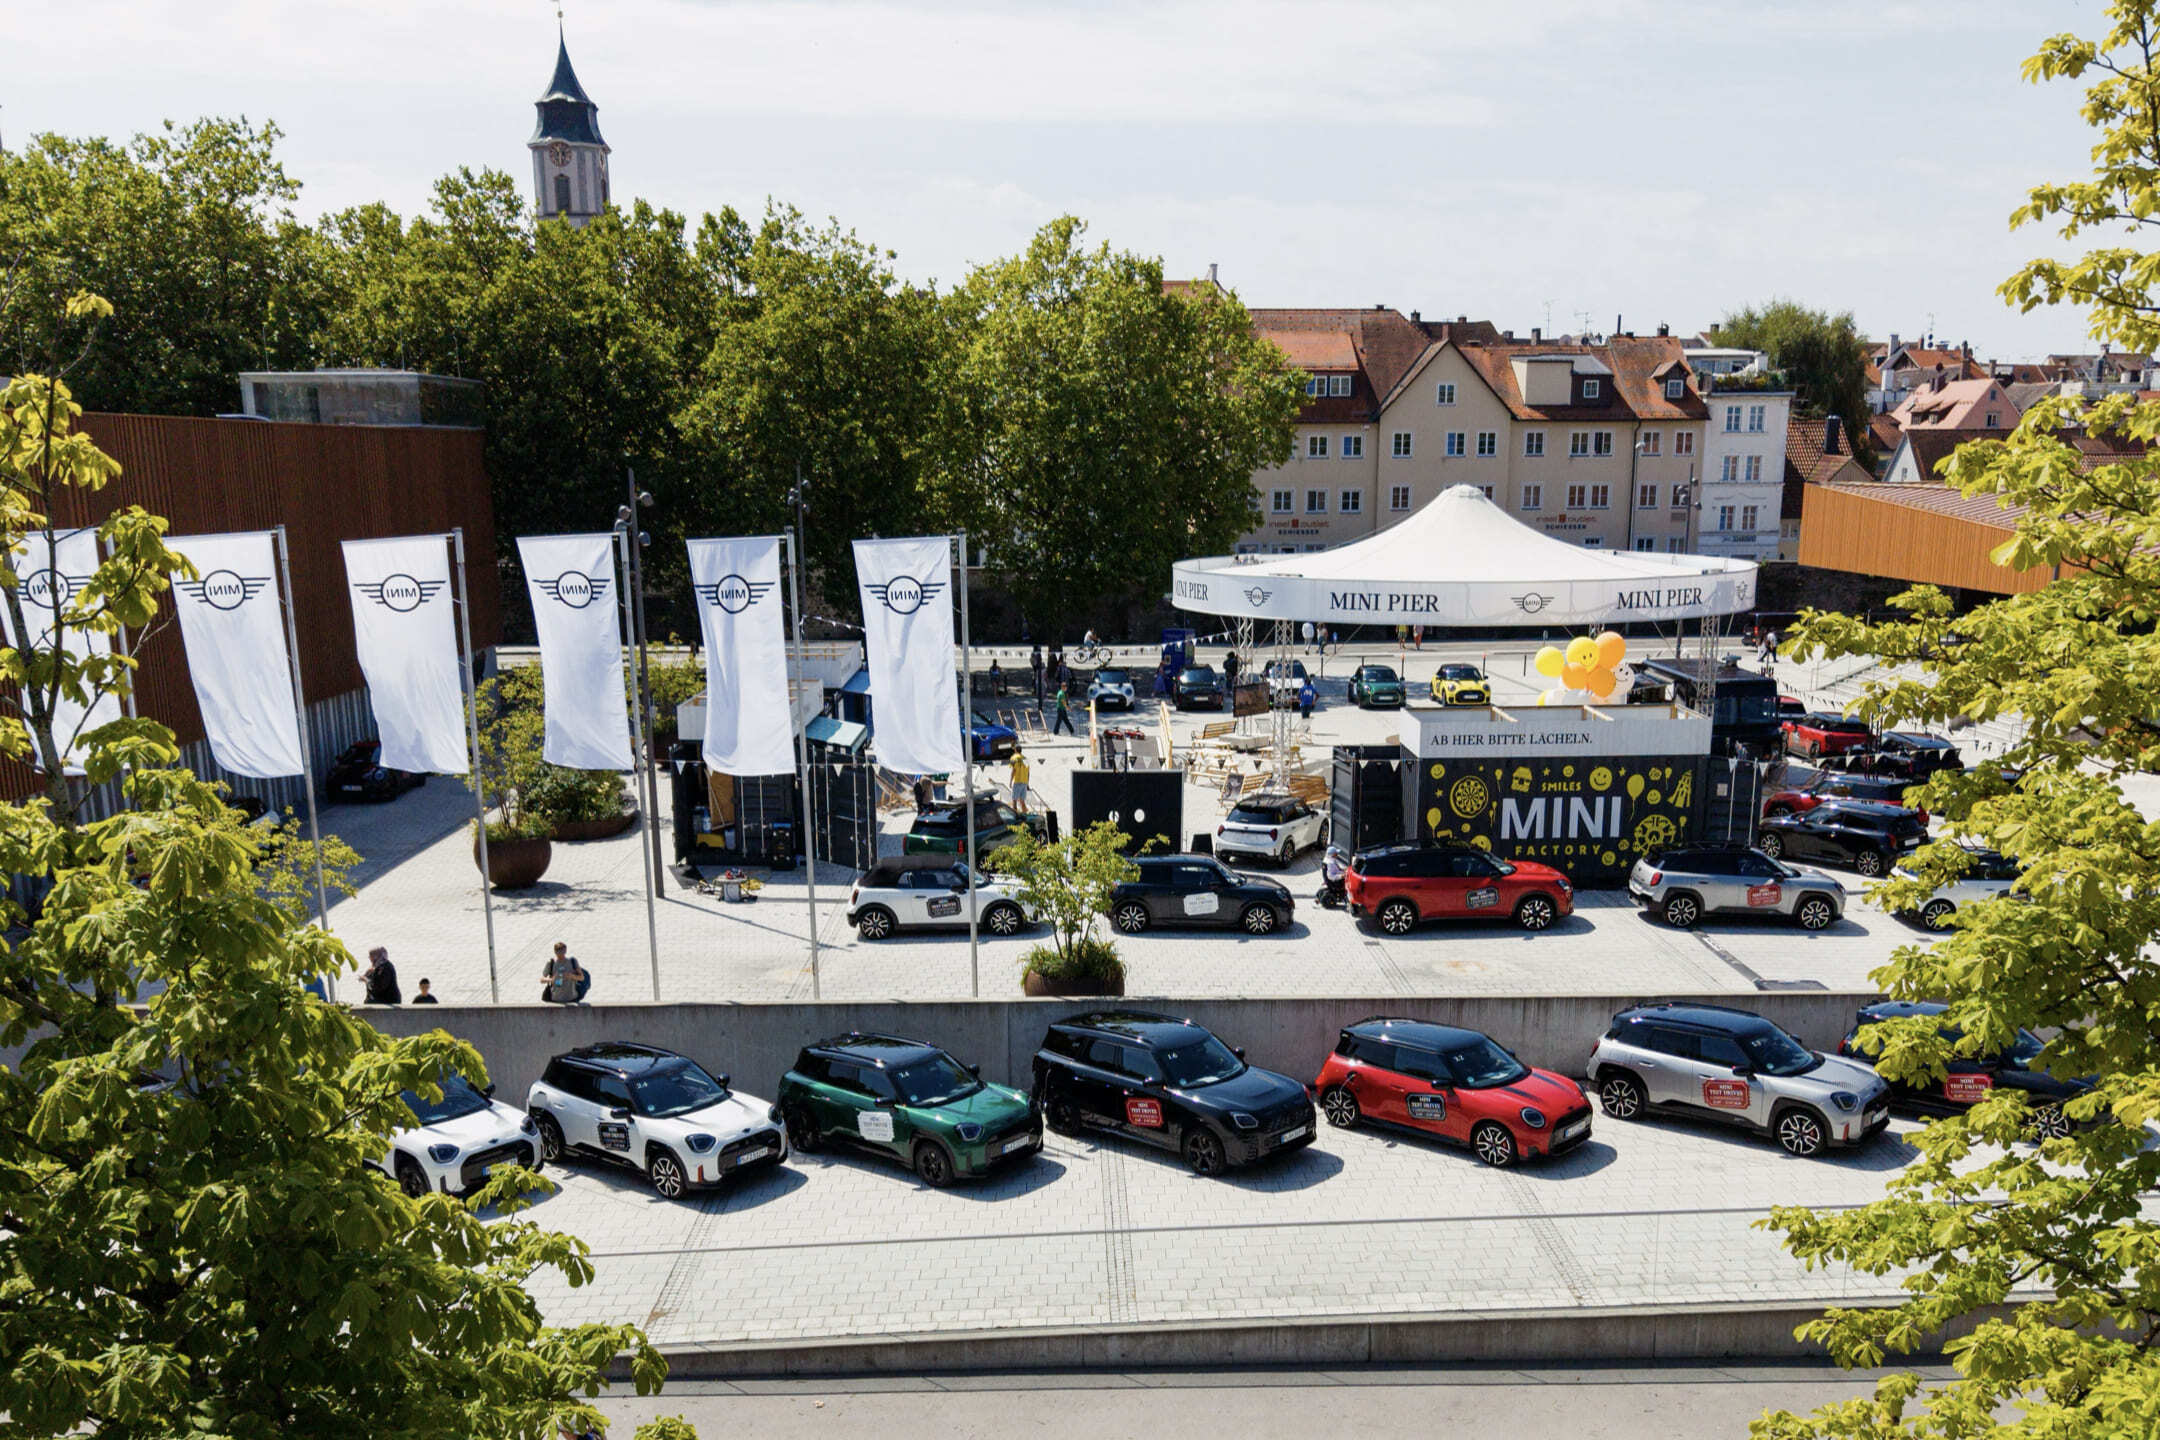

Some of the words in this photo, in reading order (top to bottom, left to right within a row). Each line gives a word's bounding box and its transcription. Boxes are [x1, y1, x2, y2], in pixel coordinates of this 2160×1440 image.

[1189, 582, 1208, 601] PIER
[1616, 590, 1661, 609] MINI
[1666, 587, 1703, 607] PIER
[1330, 592, 1380, 611] MINI
[1387, 593, 1440, 612] PIER
[1431, 734, 1449, 745] AB
[1452, 734, 1484, 745] HIER
[1488, 733, 1526, 745] BITTE
[1541, 782, 1581, 792] SMILES
[1501, 796, 1621, 839] MINI
[1515, 844, 1601, 856] FACTORY
